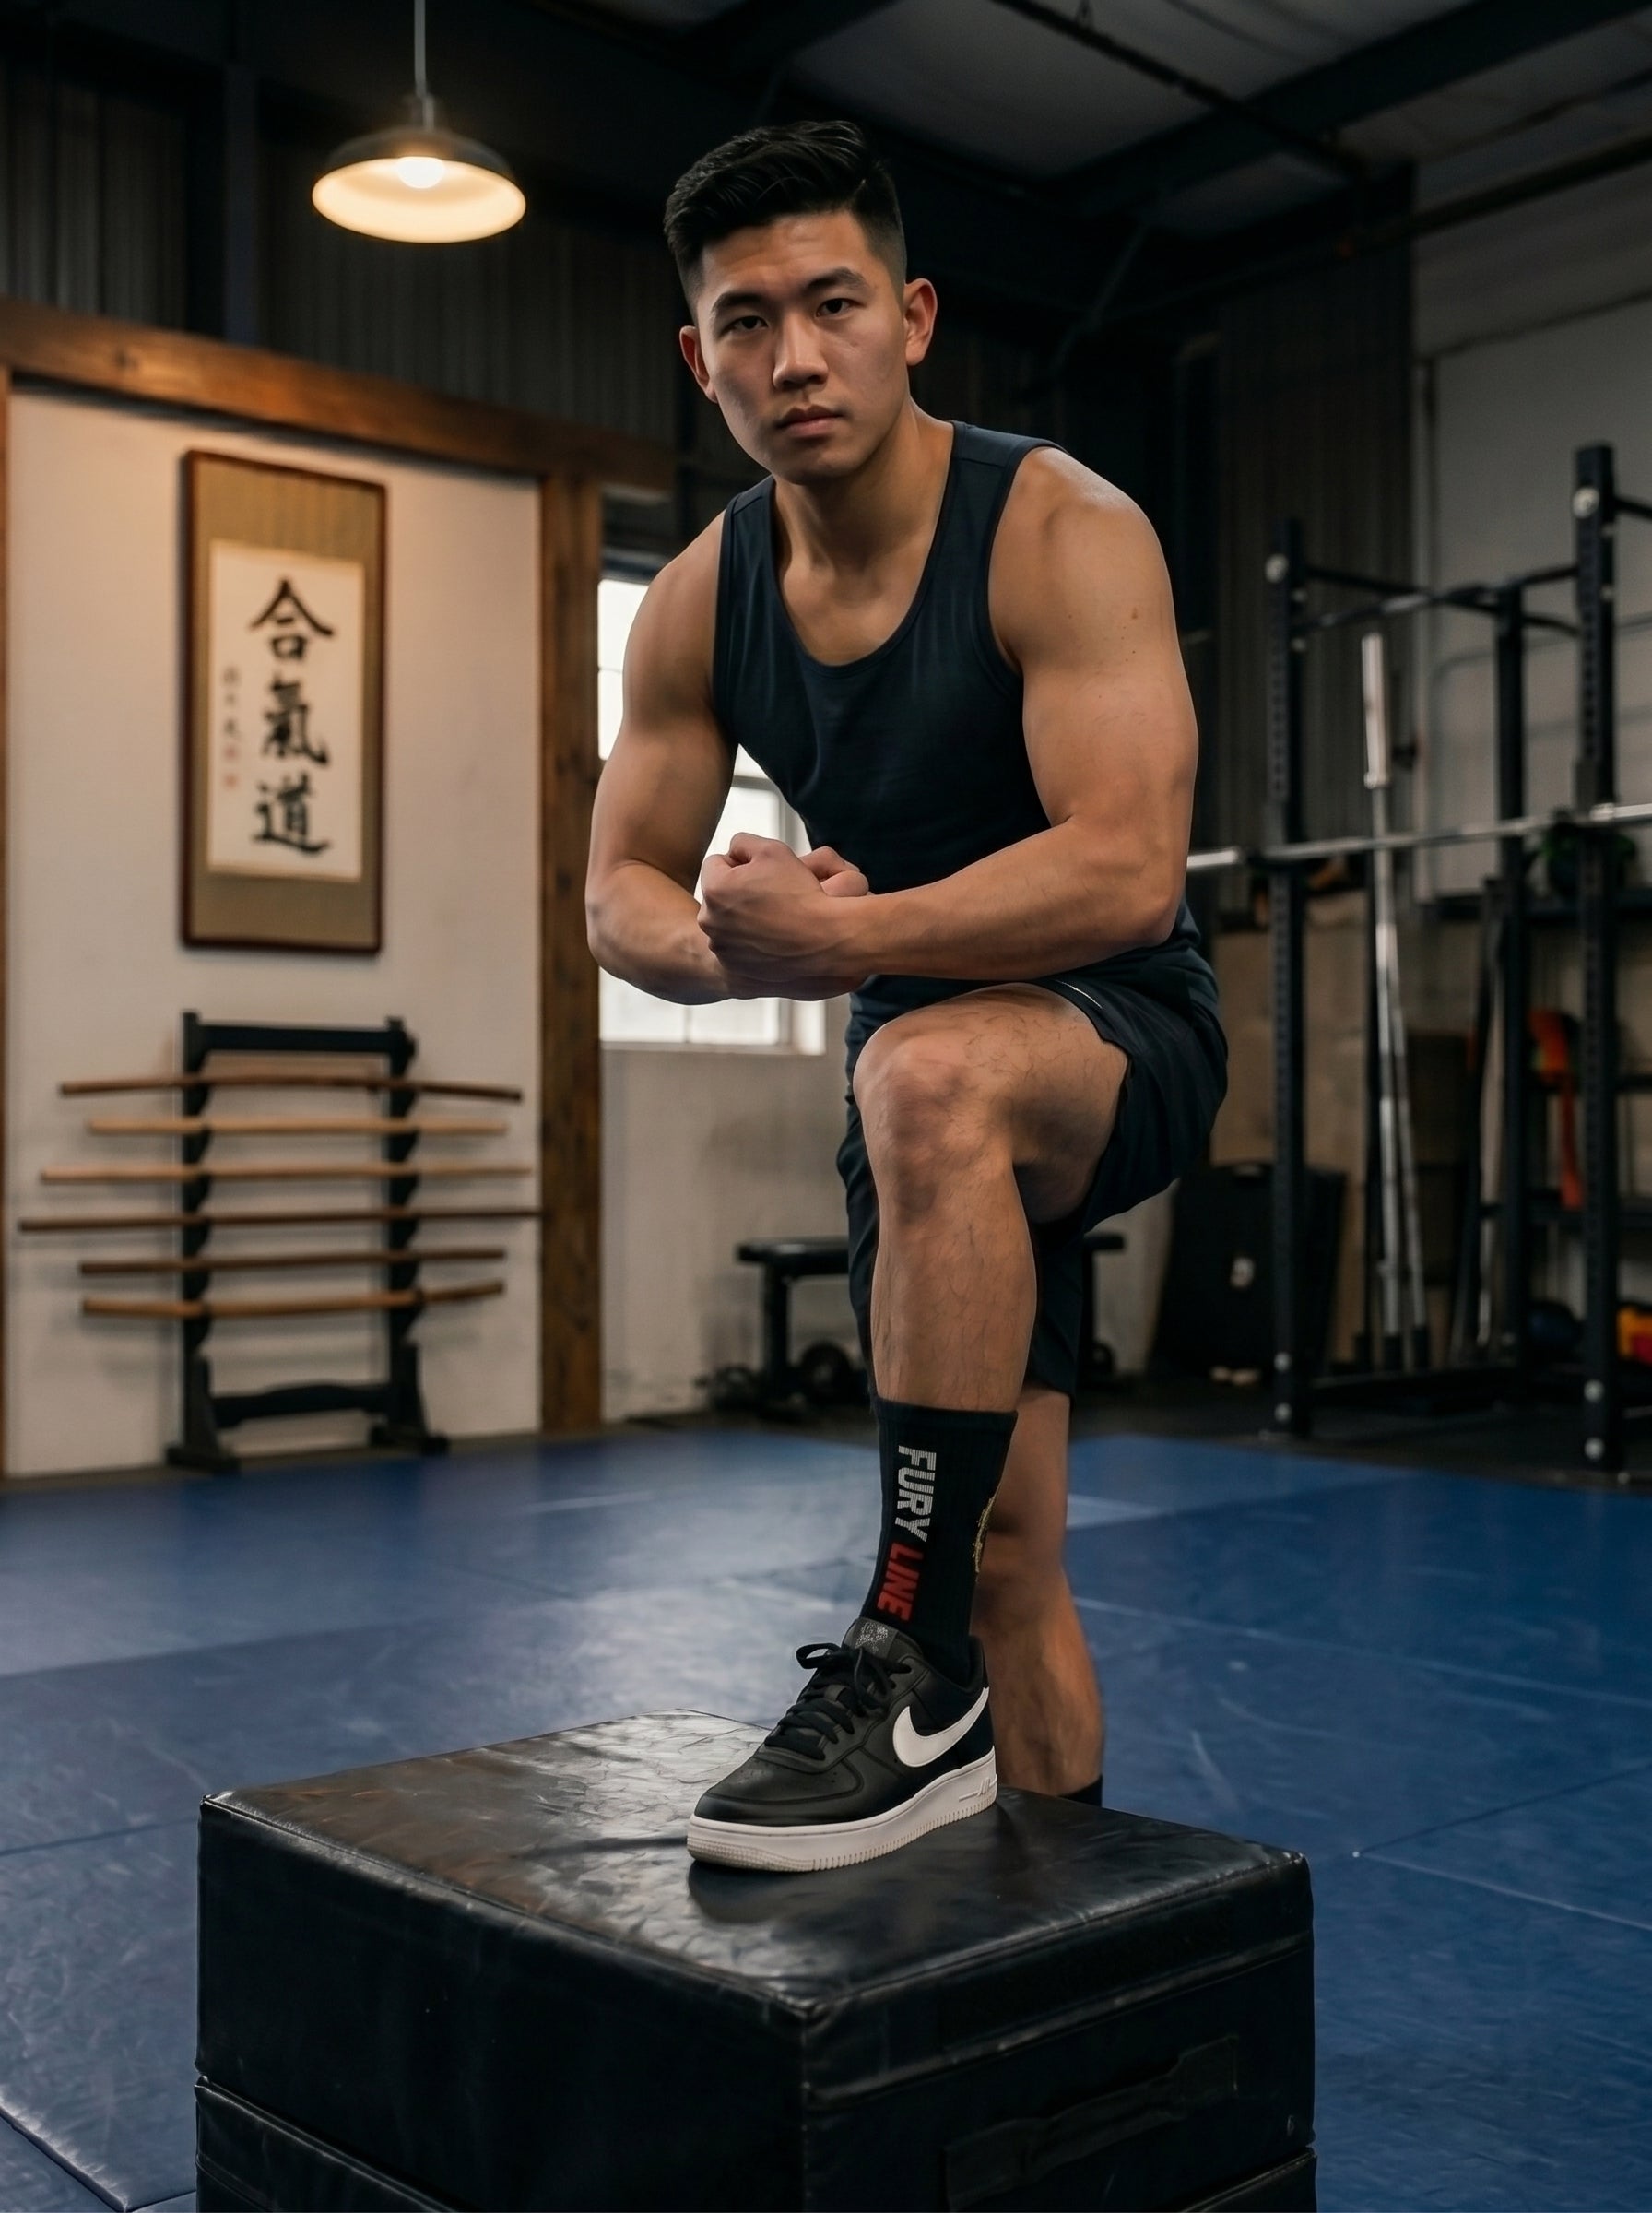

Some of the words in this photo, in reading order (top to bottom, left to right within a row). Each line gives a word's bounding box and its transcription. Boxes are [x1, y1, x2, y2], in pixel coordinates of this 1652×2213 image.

[249, 577, 335, 855] 合氣道
[895, 1445, 936, 1542] FURY
[878, 1542, 924, 1622] LINE
